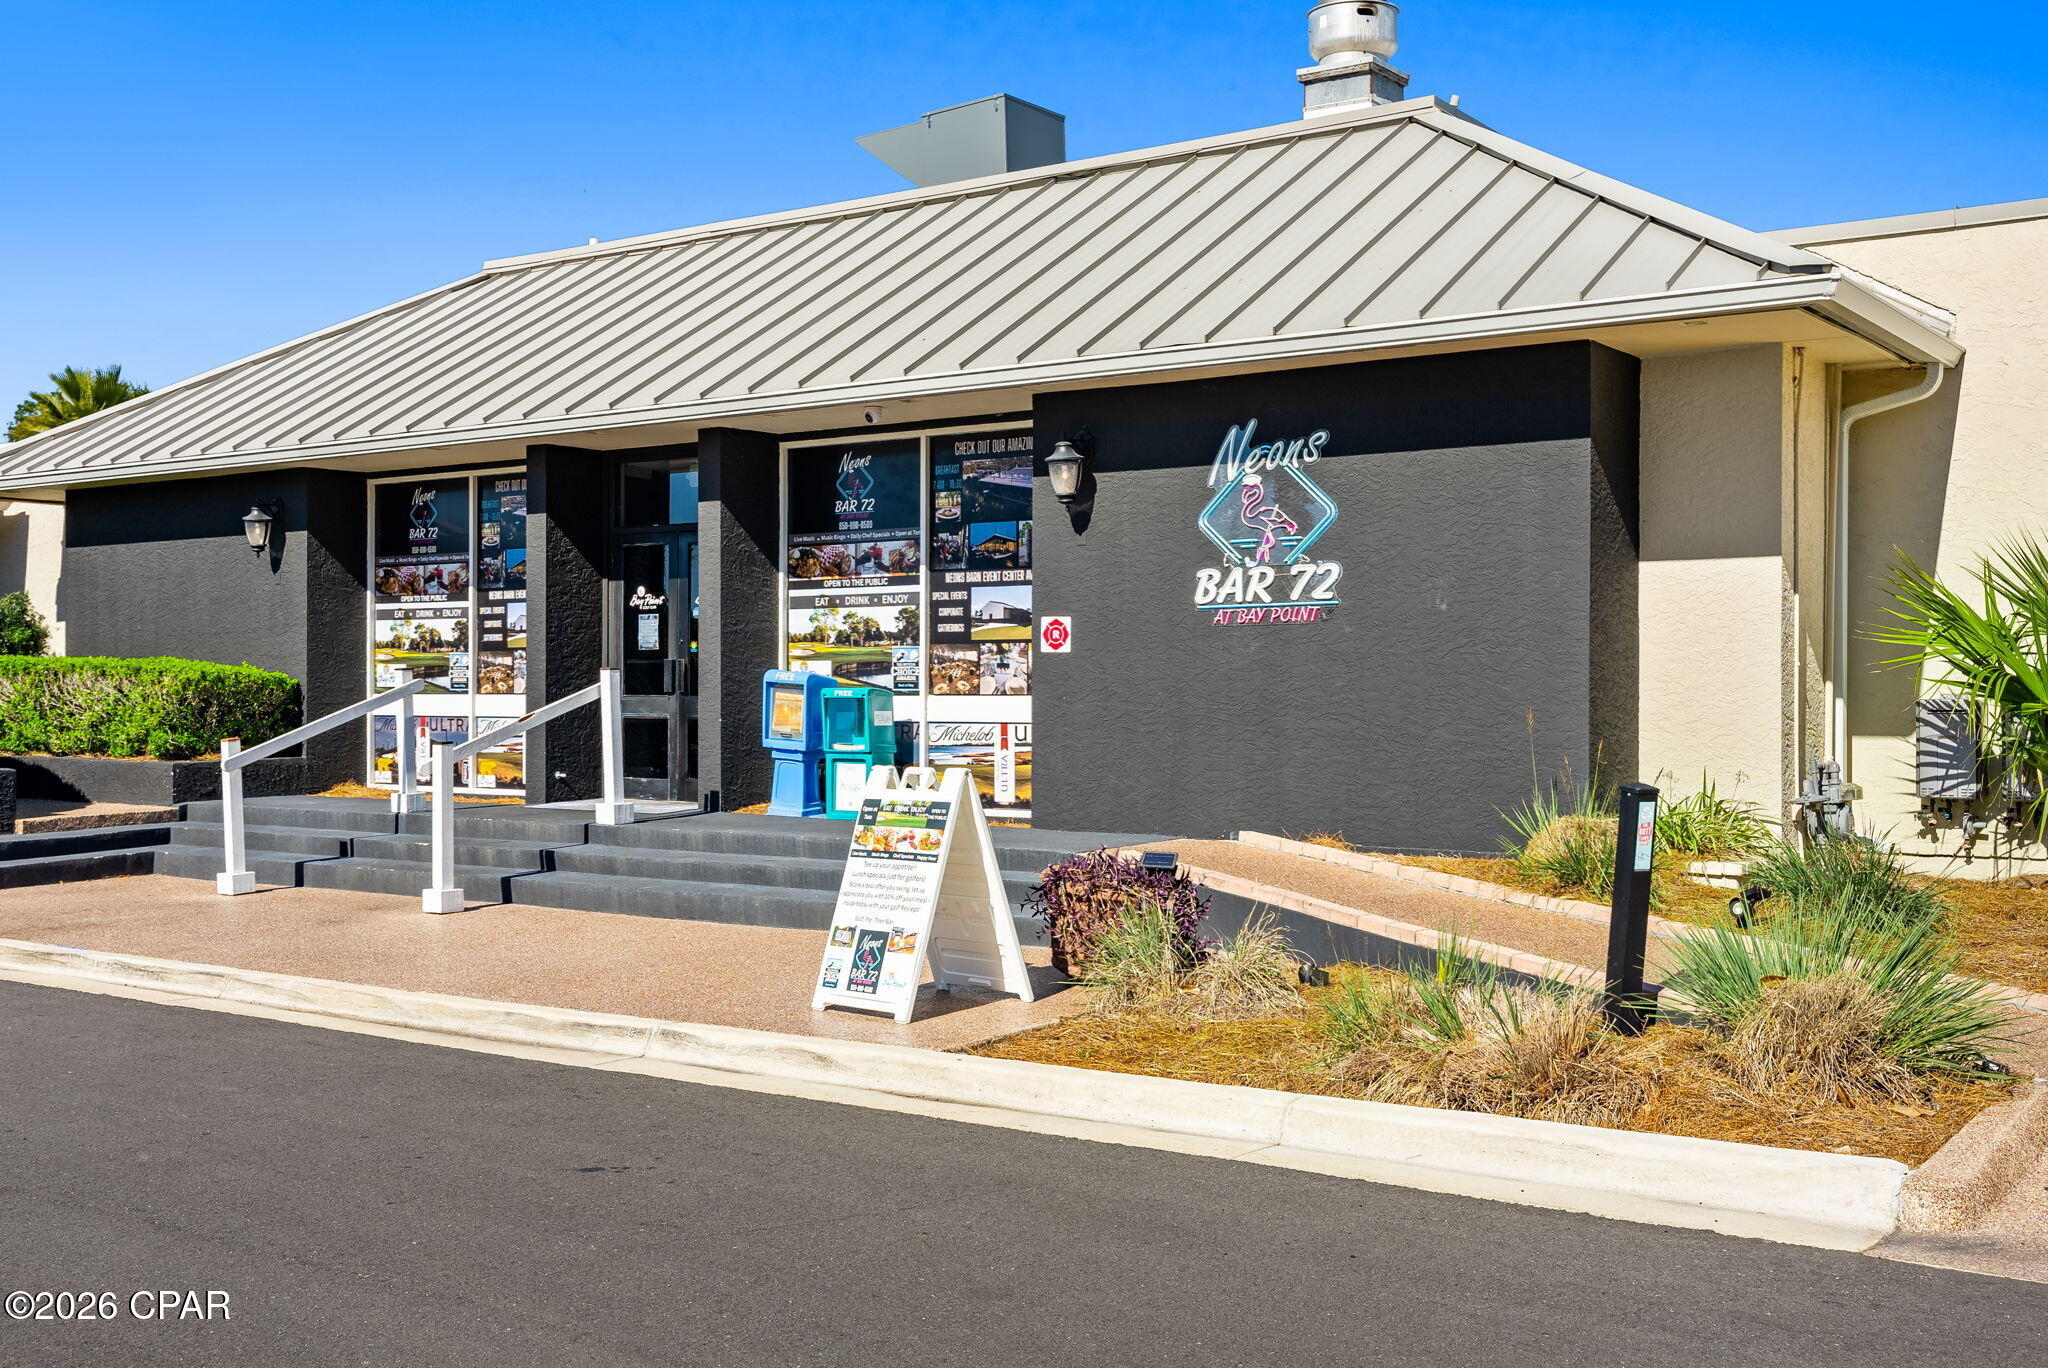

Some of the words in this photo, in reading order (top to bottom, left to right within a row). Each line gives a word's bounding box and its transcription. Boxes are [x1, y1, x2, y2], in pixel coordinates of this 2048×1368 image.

[954, 441, 975, 456] CHECK
[978, 440, 989, 453] OUT
[992, 439, 1006, 452] OUR
[1209, 419, 1329, 487] Neons
[838, 451, 872, 473] Neons
[412, 487, 435, 505] Neons
[835, 500, 858, 513] BAR
[861, 498, 875, 511] 72
[409, 528, 426, 539] BAR
[428, 527, 438, 538] 72
[824, 580, 840, 588] OPEN
[851, 579, 864, 587] THE
[865, 578, 888, 586] PUBLIC
[945, 572, 965, 583] NEONS
[966, 571, 982, 582] BARN
[983, 571, 1001, 582] EVENT
[1002, 570, 1024, 582] CENTER
[1194, 565, 1275, 604] BAR
[1290, 562, 1341, 601] 72
[815, 598, 830, 606] EAT
[845, 596, 870, 605] DRINK
[882, 594, 909, 604] ENJOY
[932, 591, 949, 600] SPECIAL
[950, 591, 968, 600] EVENTS
[394, 610, 405, 618] EAT
[442, 609, 462, 617] ENJOY
[938, 607, 964, 616] CORPORATE
[1213, 610, 1233, 624] AT
[1236, 609, 1266, 624] BAY
[1269, 607, 1321, 623] POINT
[775, 672, 795, 680] FREE
[930, 725, 996, 743] Michelob
[851, 968, 866, 979] BAR
[868, 971, 878, 980] 72
